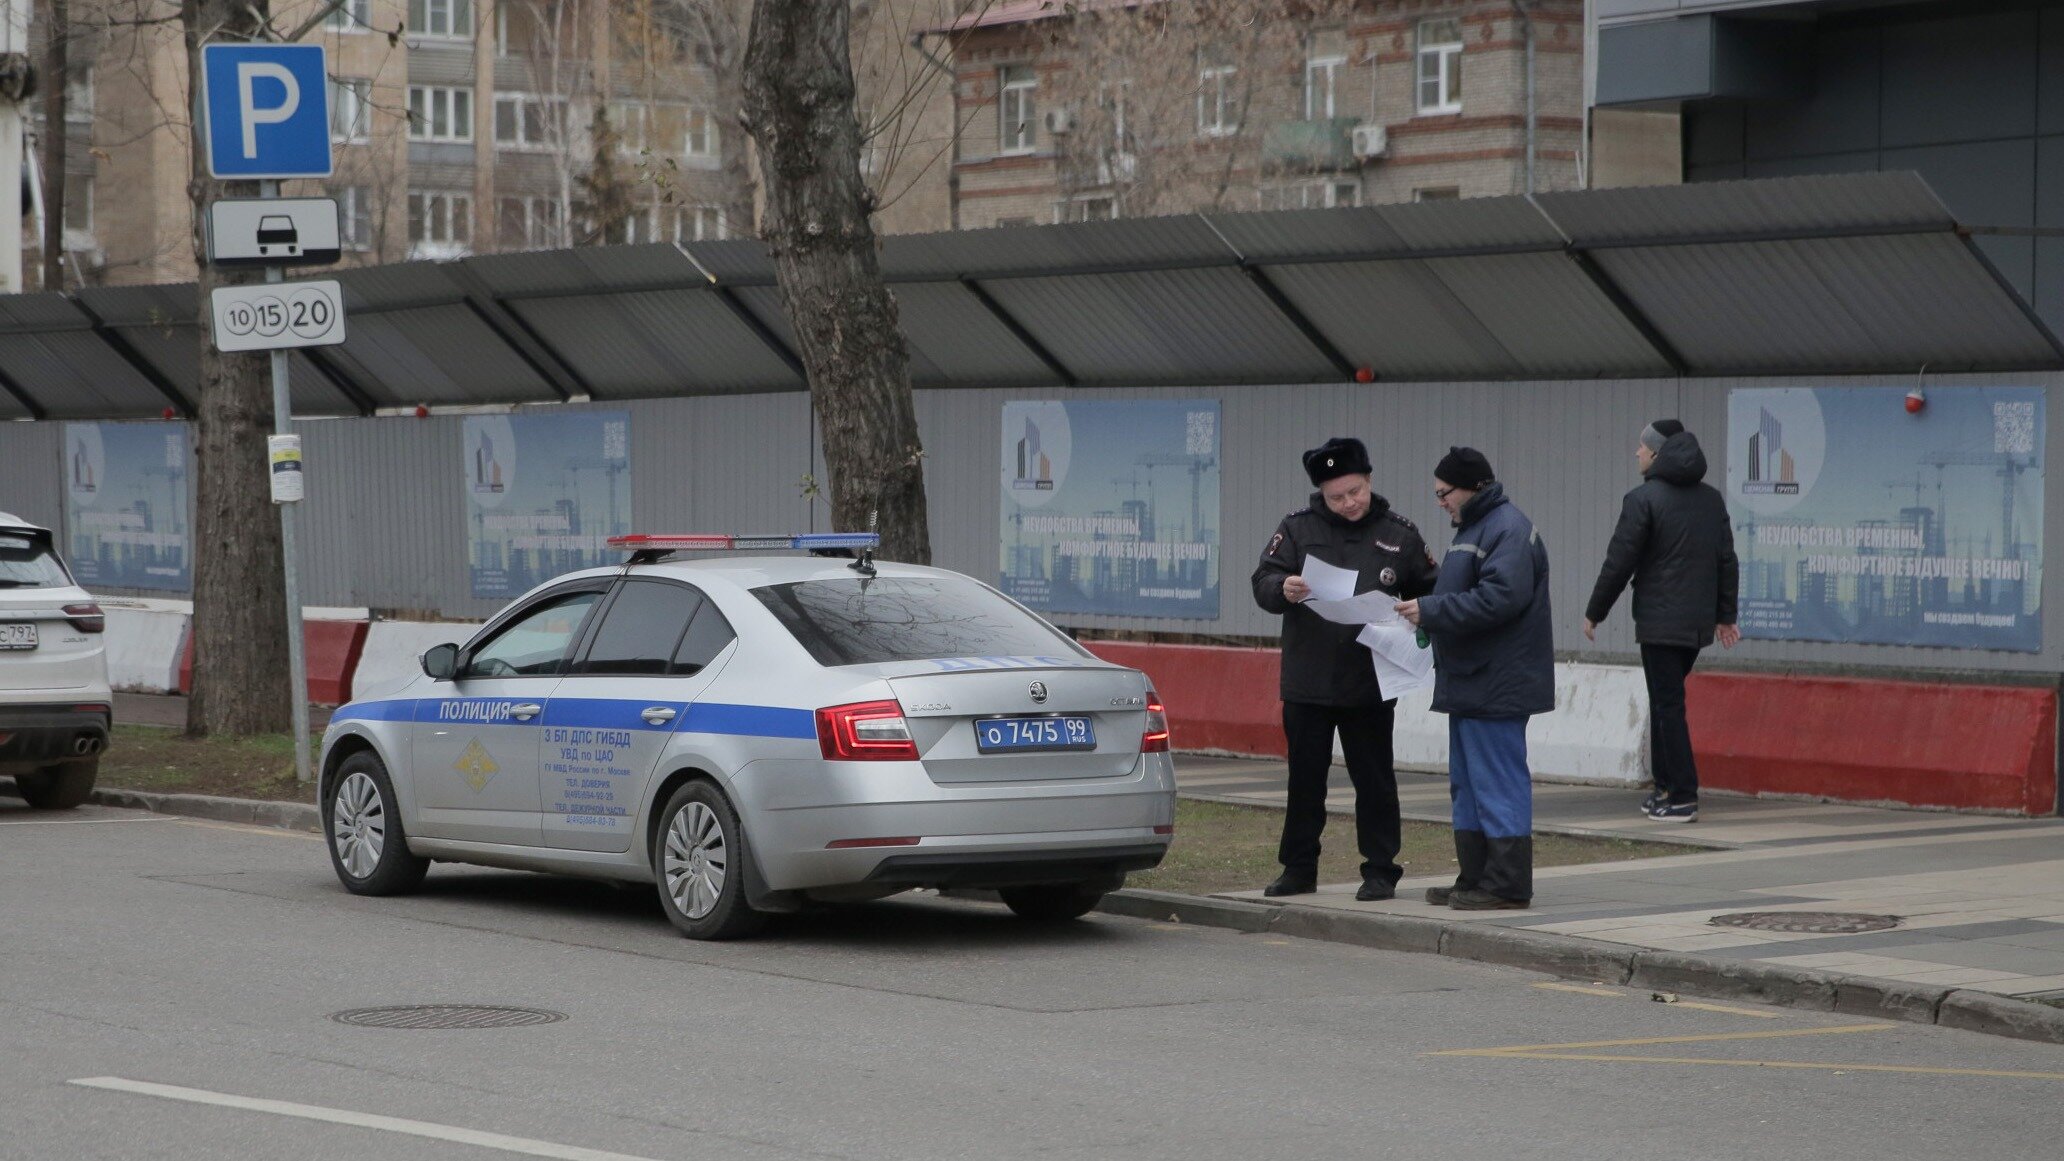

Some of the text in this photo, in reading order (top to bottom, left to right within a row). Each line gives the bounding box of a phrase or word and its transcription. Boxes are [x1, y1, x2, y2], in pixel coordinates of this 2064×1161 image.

[237, 61, 300, 159] P
[229, 300, 328, 327] 10 15 20
[1023, 516, 1082, 534] НЕУДОБСТВА
[1758, 525, 1843, 547] НЕУДОБСТВА
[1060, 541, 1125, 558] КОМФОРТНОЕ
[1127, 543, 1172, 561] БУДУЩЕЕ
[1808, 555, 1902, 577] КОМФОРТНОЕ
[1906, 557, 1968, 580] БУДУЩЕЕ
[1972, 559, 2020, 580] ВЕЧНО
[10, 626, 32, 639] 797
[439, 701, 511, 723] ПОЛИЦИЯ
[554, 730, 568, 743] БП
[570, 730, 592, 746] ДПС
[596, 731, 631, 748] ГИБДД
[1007, 721, 1058, 744] 7475
[1066, 720, 1086, 736] 99
[561, 748, 614, 763] УВД по ЦАО
[553, 764, 567, 774] МВД
[568, 765, 590, 773] России
[607, 767, 631, 775] Москве
[581, 779, 610, 789] ДОВЕРИЯ
